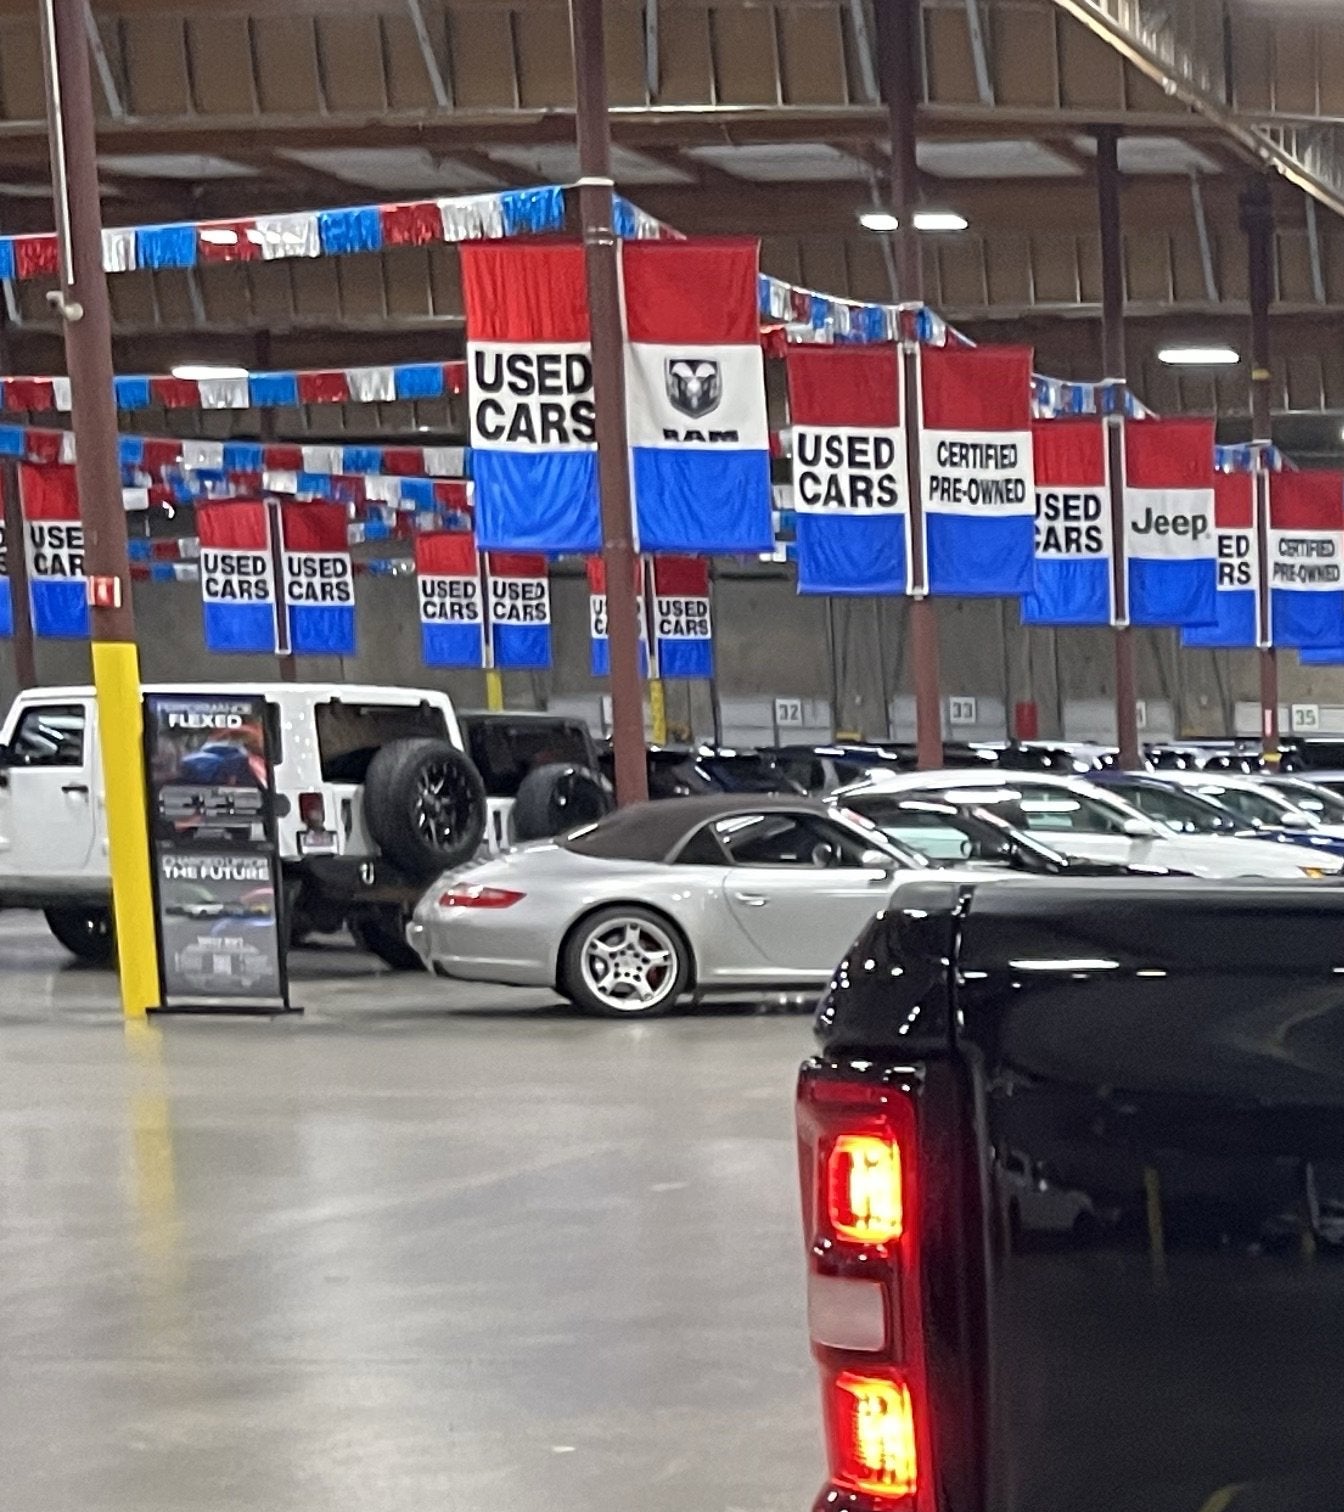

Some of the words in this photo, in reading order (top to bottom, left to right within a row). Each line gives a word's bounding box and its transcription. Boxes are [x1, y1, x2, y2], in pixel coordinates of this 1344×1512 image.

[475, 351, 592, 396] USED
[476, 398, 595, 444] CARS
[798, 433, 895, 470] USED
[937, 440, 1018, 470] CERTIFIED
[799, 471, 898, 507] CARS
[929, 475, 1026, 505] PRE-OWNED
[1131, 507, 1208, 541] Jeep
[30, 525, 84, 549] USE
[1278, 538, 1335, 558] CERTIFIED
[34, 552, 85, 576] CAR
[204, 553, 267, 576] USED
[288, 556, 348, 578] USED
[1272, 562, 1340, 583] PRE-OWNED
[205, 577, 270, 600] CARS
[288, 580, 350, 601] CARS
[422, 580, 477, 598] USED
[493, 581, 545, 600] USED
[423, 601, 479, 620] CARS
[493, 602, 547, 621] CARS
[658, 600, 708, 617] USED
[659, 619, 709, 635] CARS
[168, 713, 243, 729] FLEXED
[164, 865, 198, 879] THE
[201, 866, 269, 880] FUTURE
